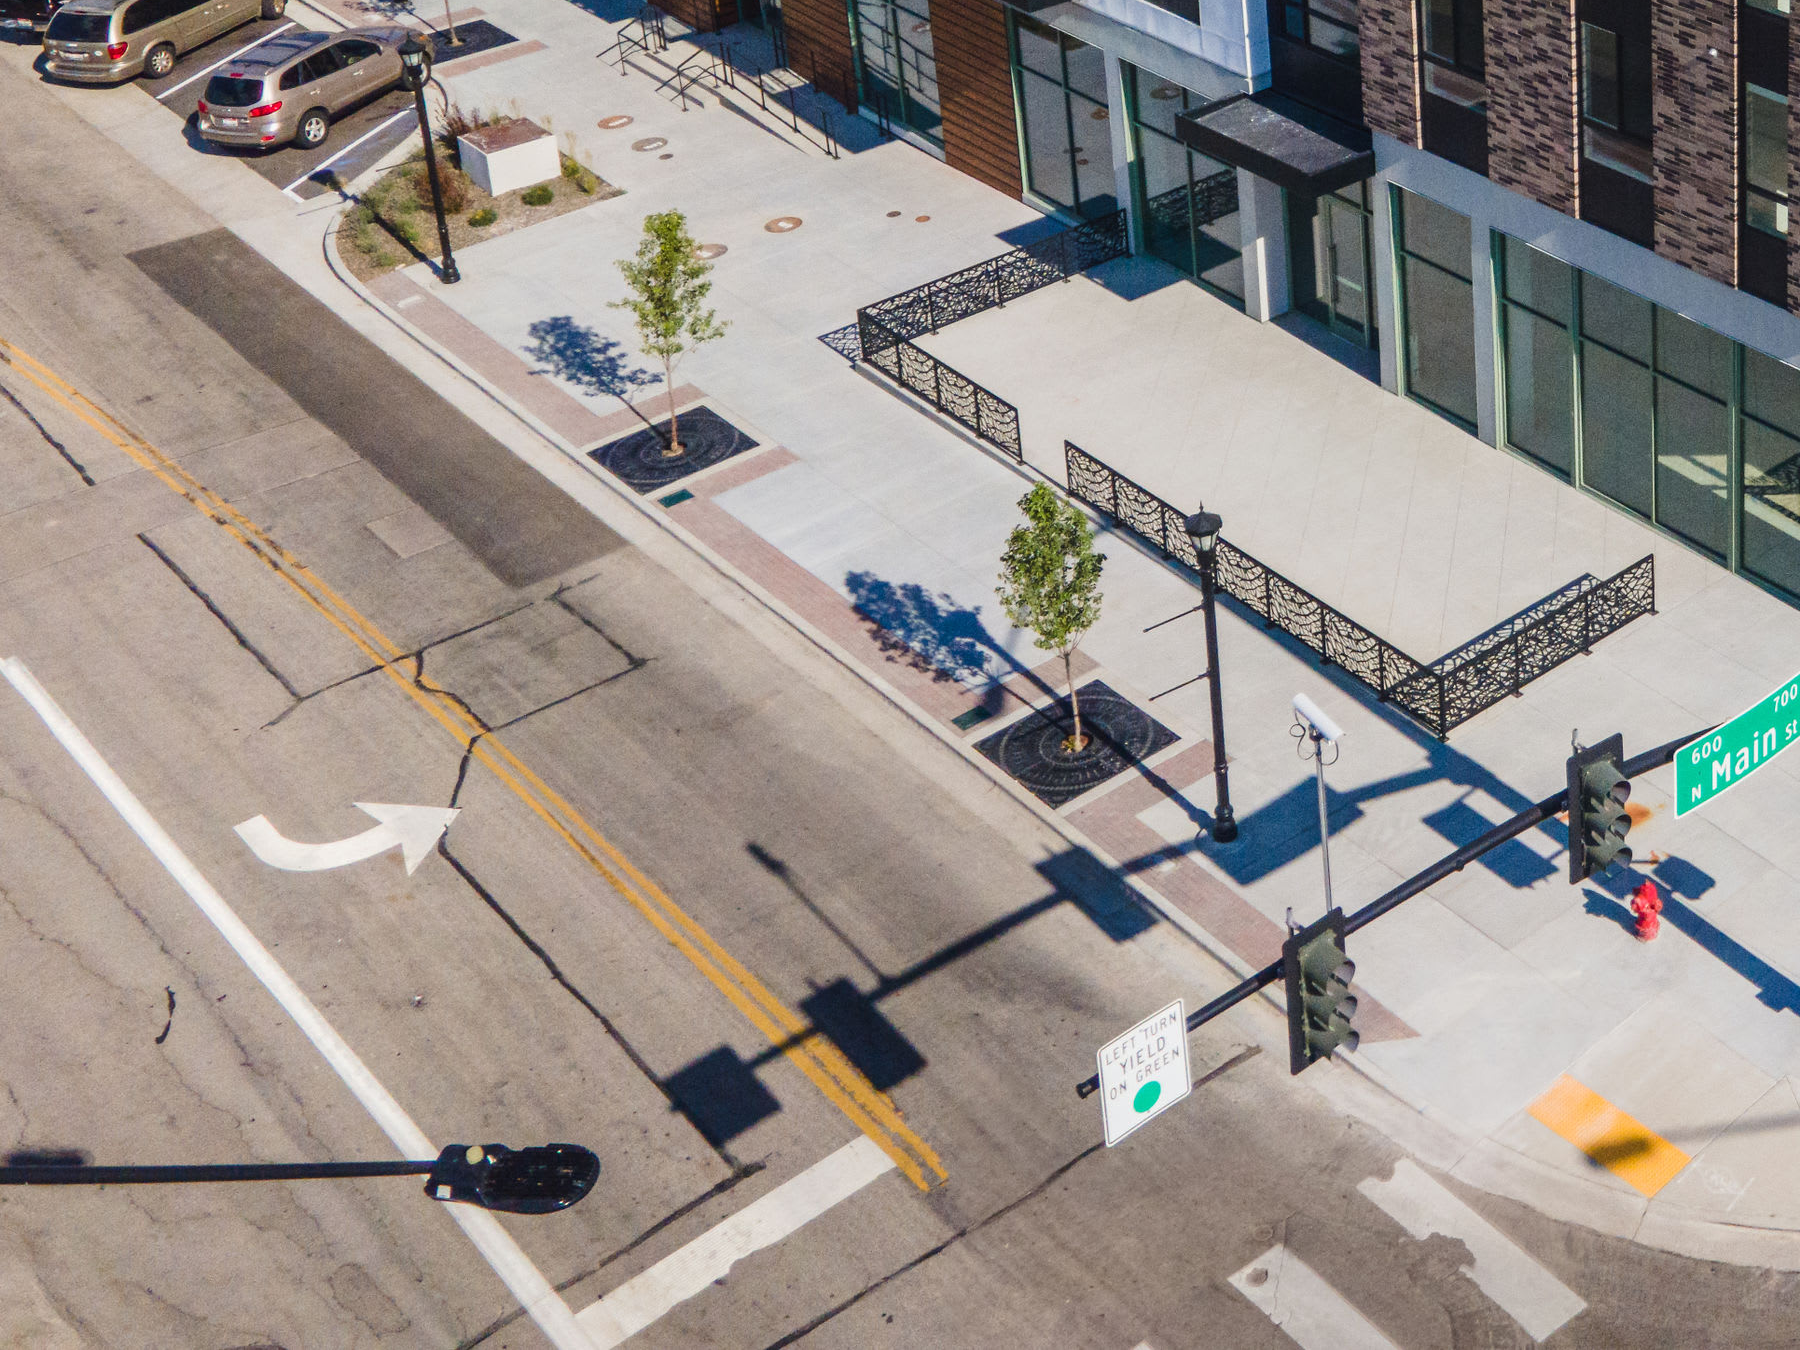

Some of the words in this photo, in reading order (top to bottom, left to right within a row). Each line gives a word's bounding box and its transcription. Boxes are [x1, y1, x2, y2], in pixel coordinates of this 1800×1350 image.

[1773, 684, 1798, 712] 700
[1691, 735, 1722, 765] 600
[1691, 784, 1702, 803] N
[1712, 727, 1776, 790] Main
[1785, 719, 1798, 741] St
[1105, 1035, 1136, 1066] LEFT
[1140, 1011, 1177, 1040] TURN
[1120, 1036, 1166, 1075] YIELD
[1110, 1079, 1127, 1100] ON
[1135, 1045, 1180, 1083] GREEN
